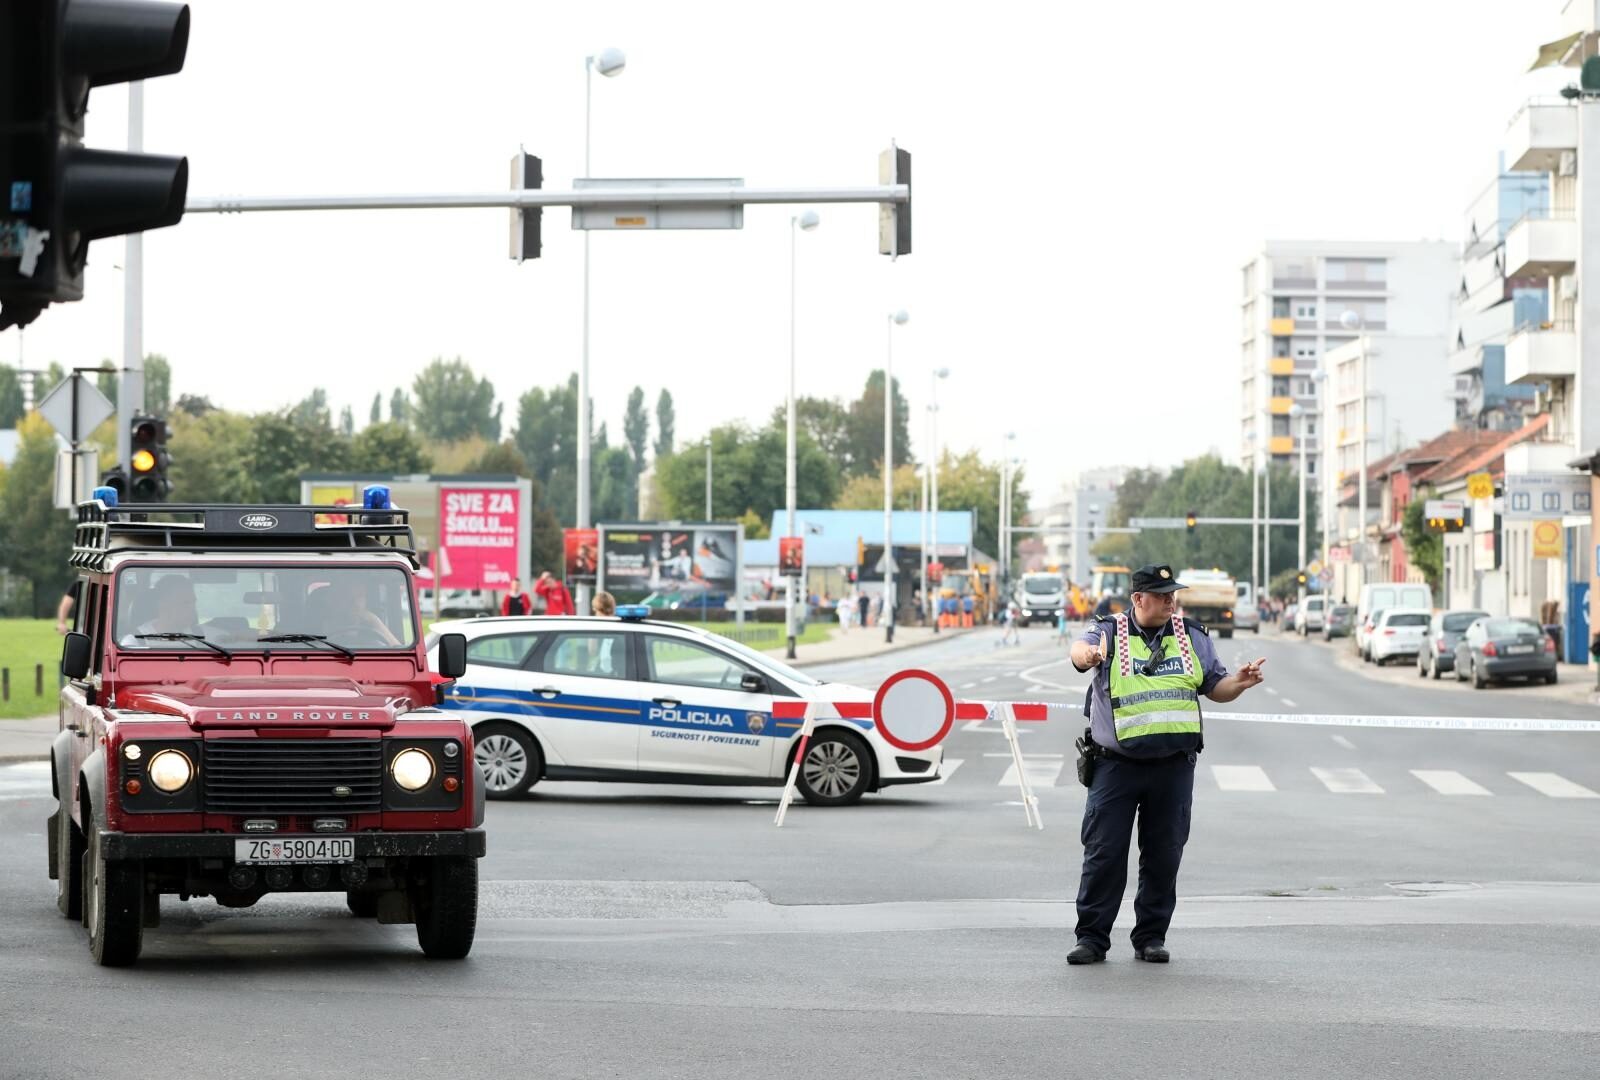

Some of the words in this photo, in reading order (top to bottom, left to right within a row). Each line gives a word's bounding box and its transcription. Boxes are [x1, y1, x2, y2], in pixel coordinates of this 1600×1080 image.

[446, 493, 484, 513] SVE
[488, 493, 515, 514] ZA
[1149, 690, 1181, 699] POLICIJA
[216, 712, 278, 720] LAND
[293, 712, 370, 720] ROVER
[648, 707, 734, 728] POLICIJA
[651, 729, 700, 741] SIGURNOST
[707, 735, 760, 747] POVJERENJE
[249, 841, 271, 859] ZG
